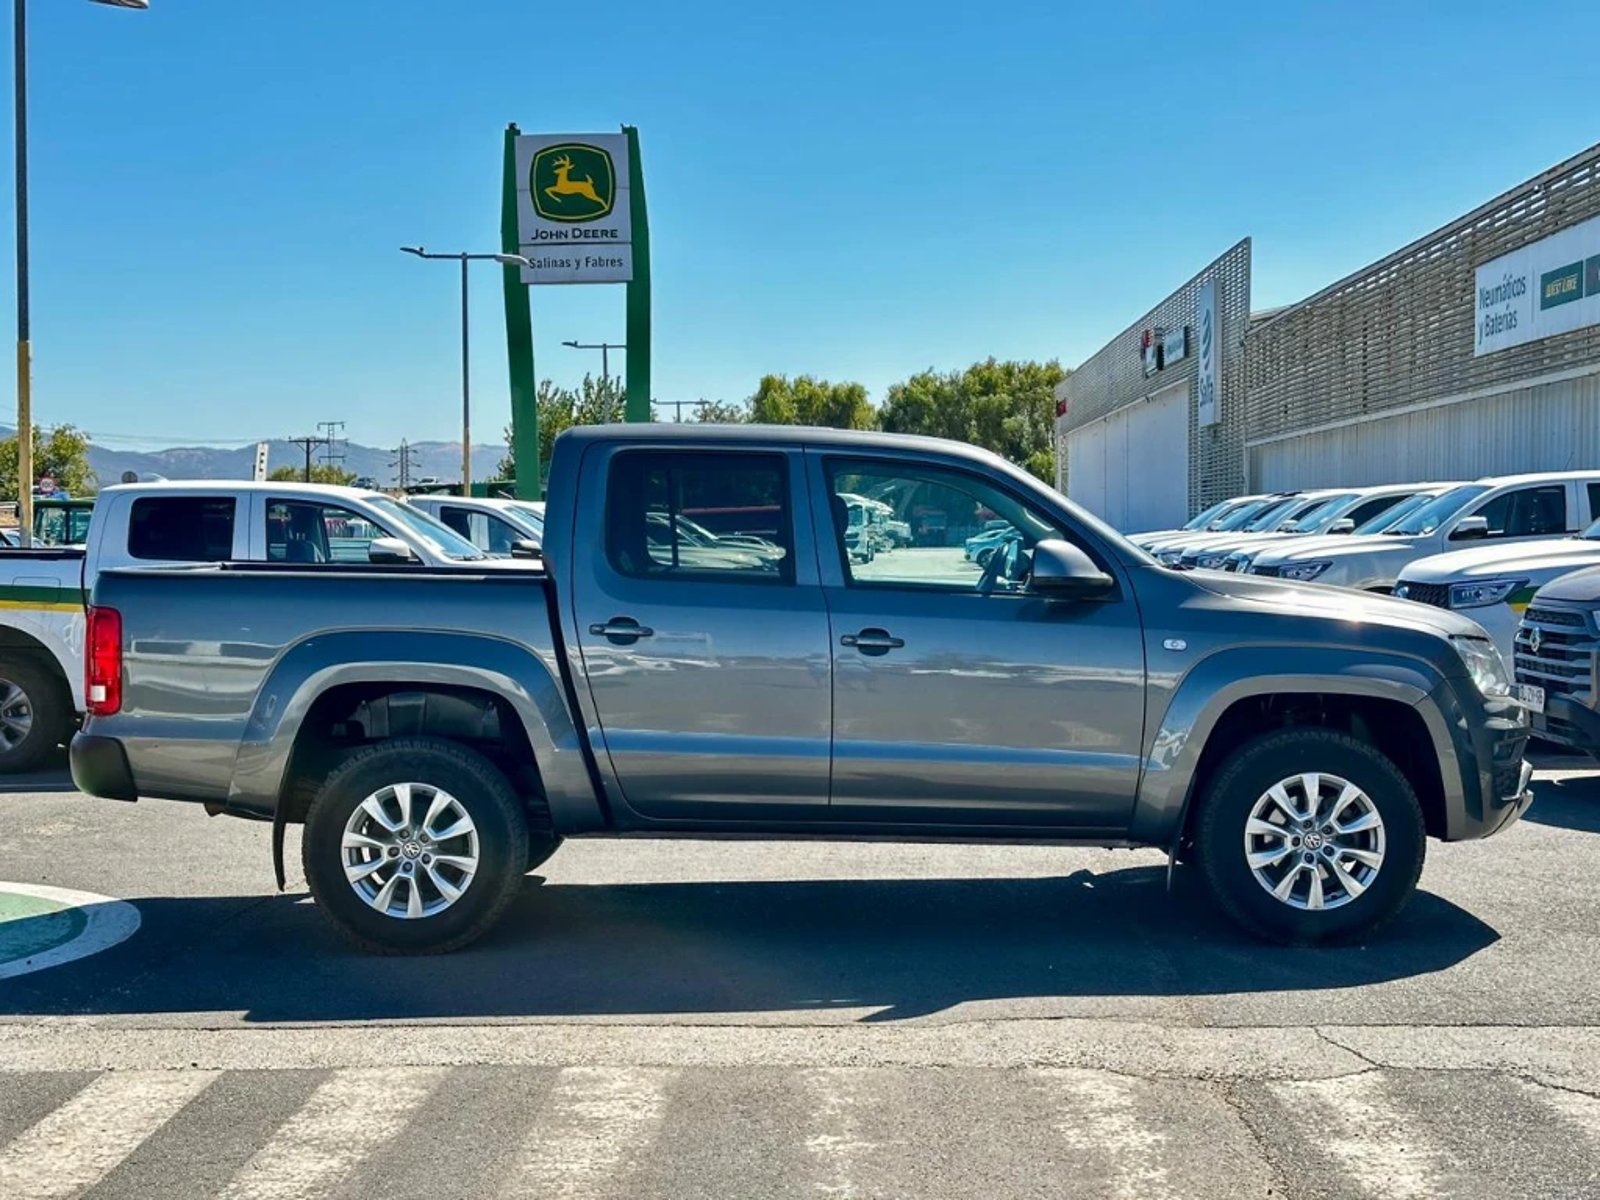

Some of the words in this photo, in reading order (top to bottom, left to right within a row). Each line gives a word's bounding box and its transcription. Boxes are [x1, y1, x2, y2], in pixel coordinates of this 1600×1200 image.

[531, 229, 568, 240] JOHN
[571, 228, 618, 239] DEERE
[528, 257, 571, 269] Salinas
[574, 259, 581, 270] y
[585, 256, 623, 268] Fabres
[1479, 272, 1526, 310] Neumáticos
[1478, 321, 1484, 345] y
[1485, 304, 1517, 338] Baterías
